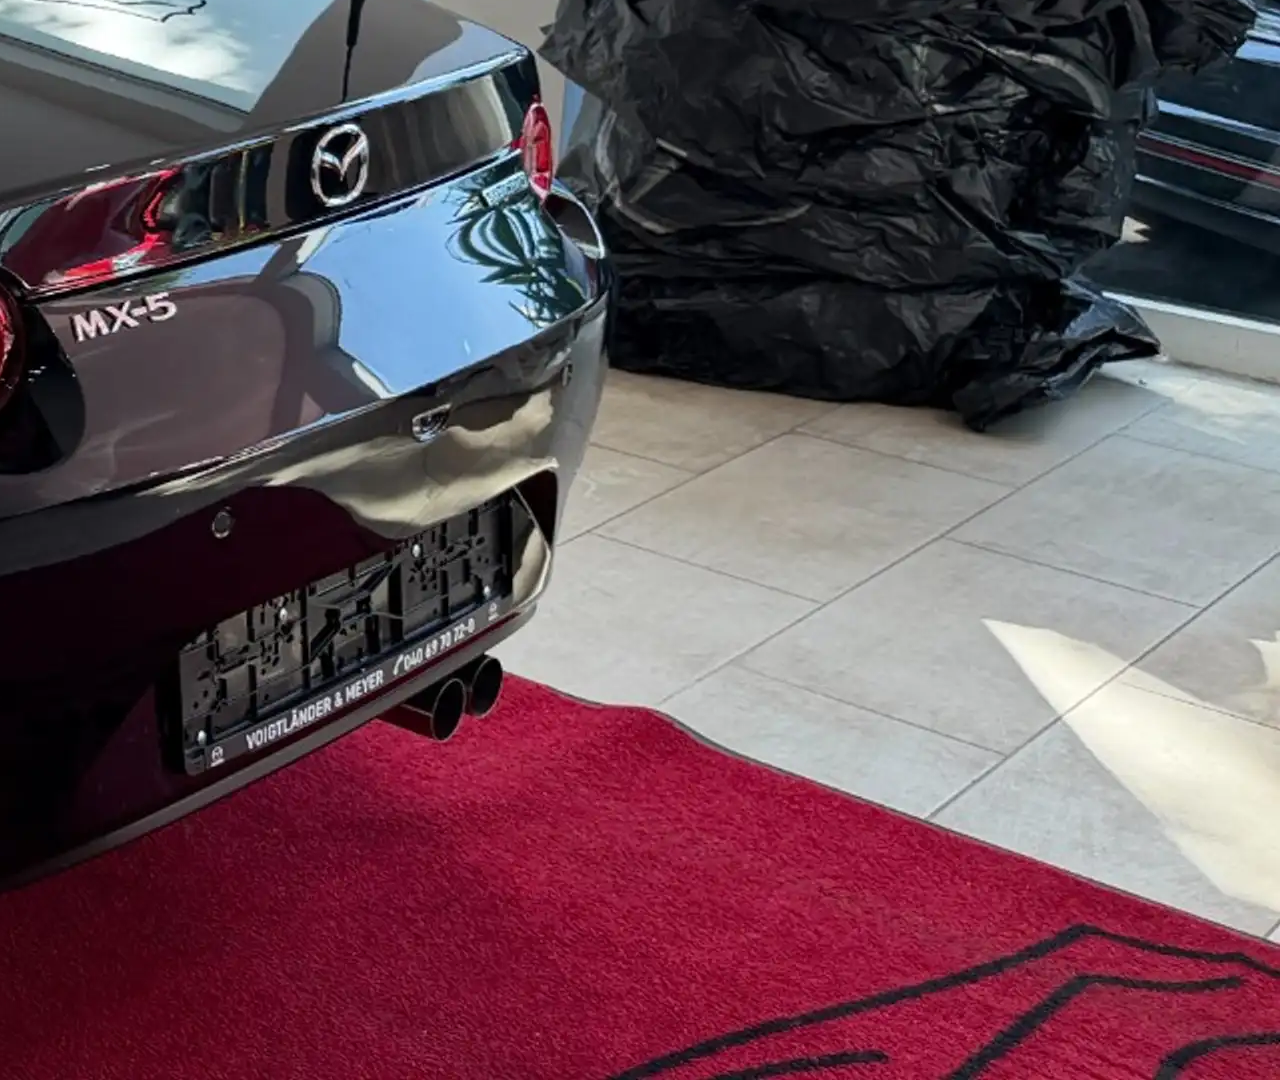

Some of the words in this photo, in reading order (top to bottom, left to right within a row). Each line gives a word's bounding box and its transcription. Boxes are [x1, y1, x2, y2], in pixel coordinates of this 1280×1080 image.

[70, 291, 178, 342] MX-5
[245, 697, 332, 749] VOIGTLÄNDER
[333, 691, 344, 708] &
[345, 669, 385, 703] MEYER
[403, 648, 424, 671] 040
